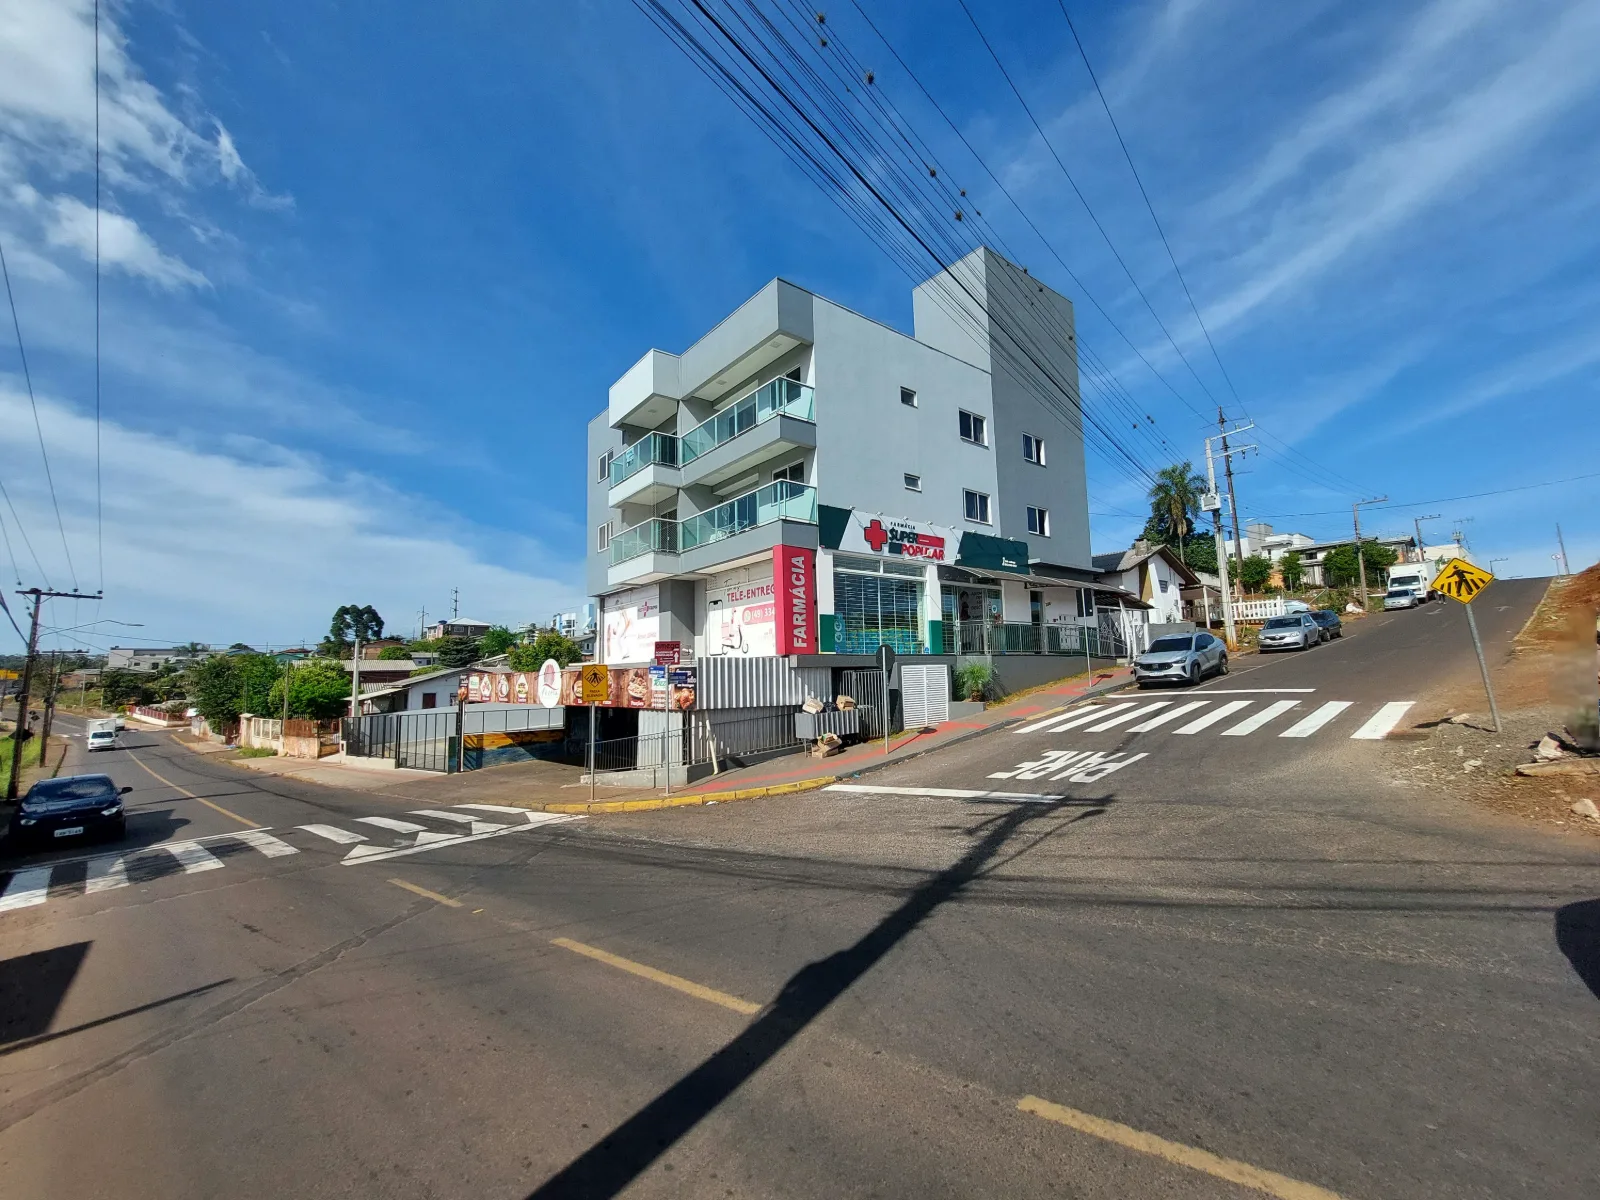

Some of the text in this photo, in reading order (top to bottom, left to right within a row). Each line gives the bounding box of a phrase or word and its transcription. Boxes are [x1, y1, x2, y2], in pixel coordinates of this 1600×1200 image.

[890, 521, 916, 530] FARMÁCIA
[889, 527, 919, 544] SUPER
[901, 543, 945, 561] POPULAR
[727, 584, 774, 602] TELE-ENTREG
[789, 556, 807, 648] FARMÁCIA
